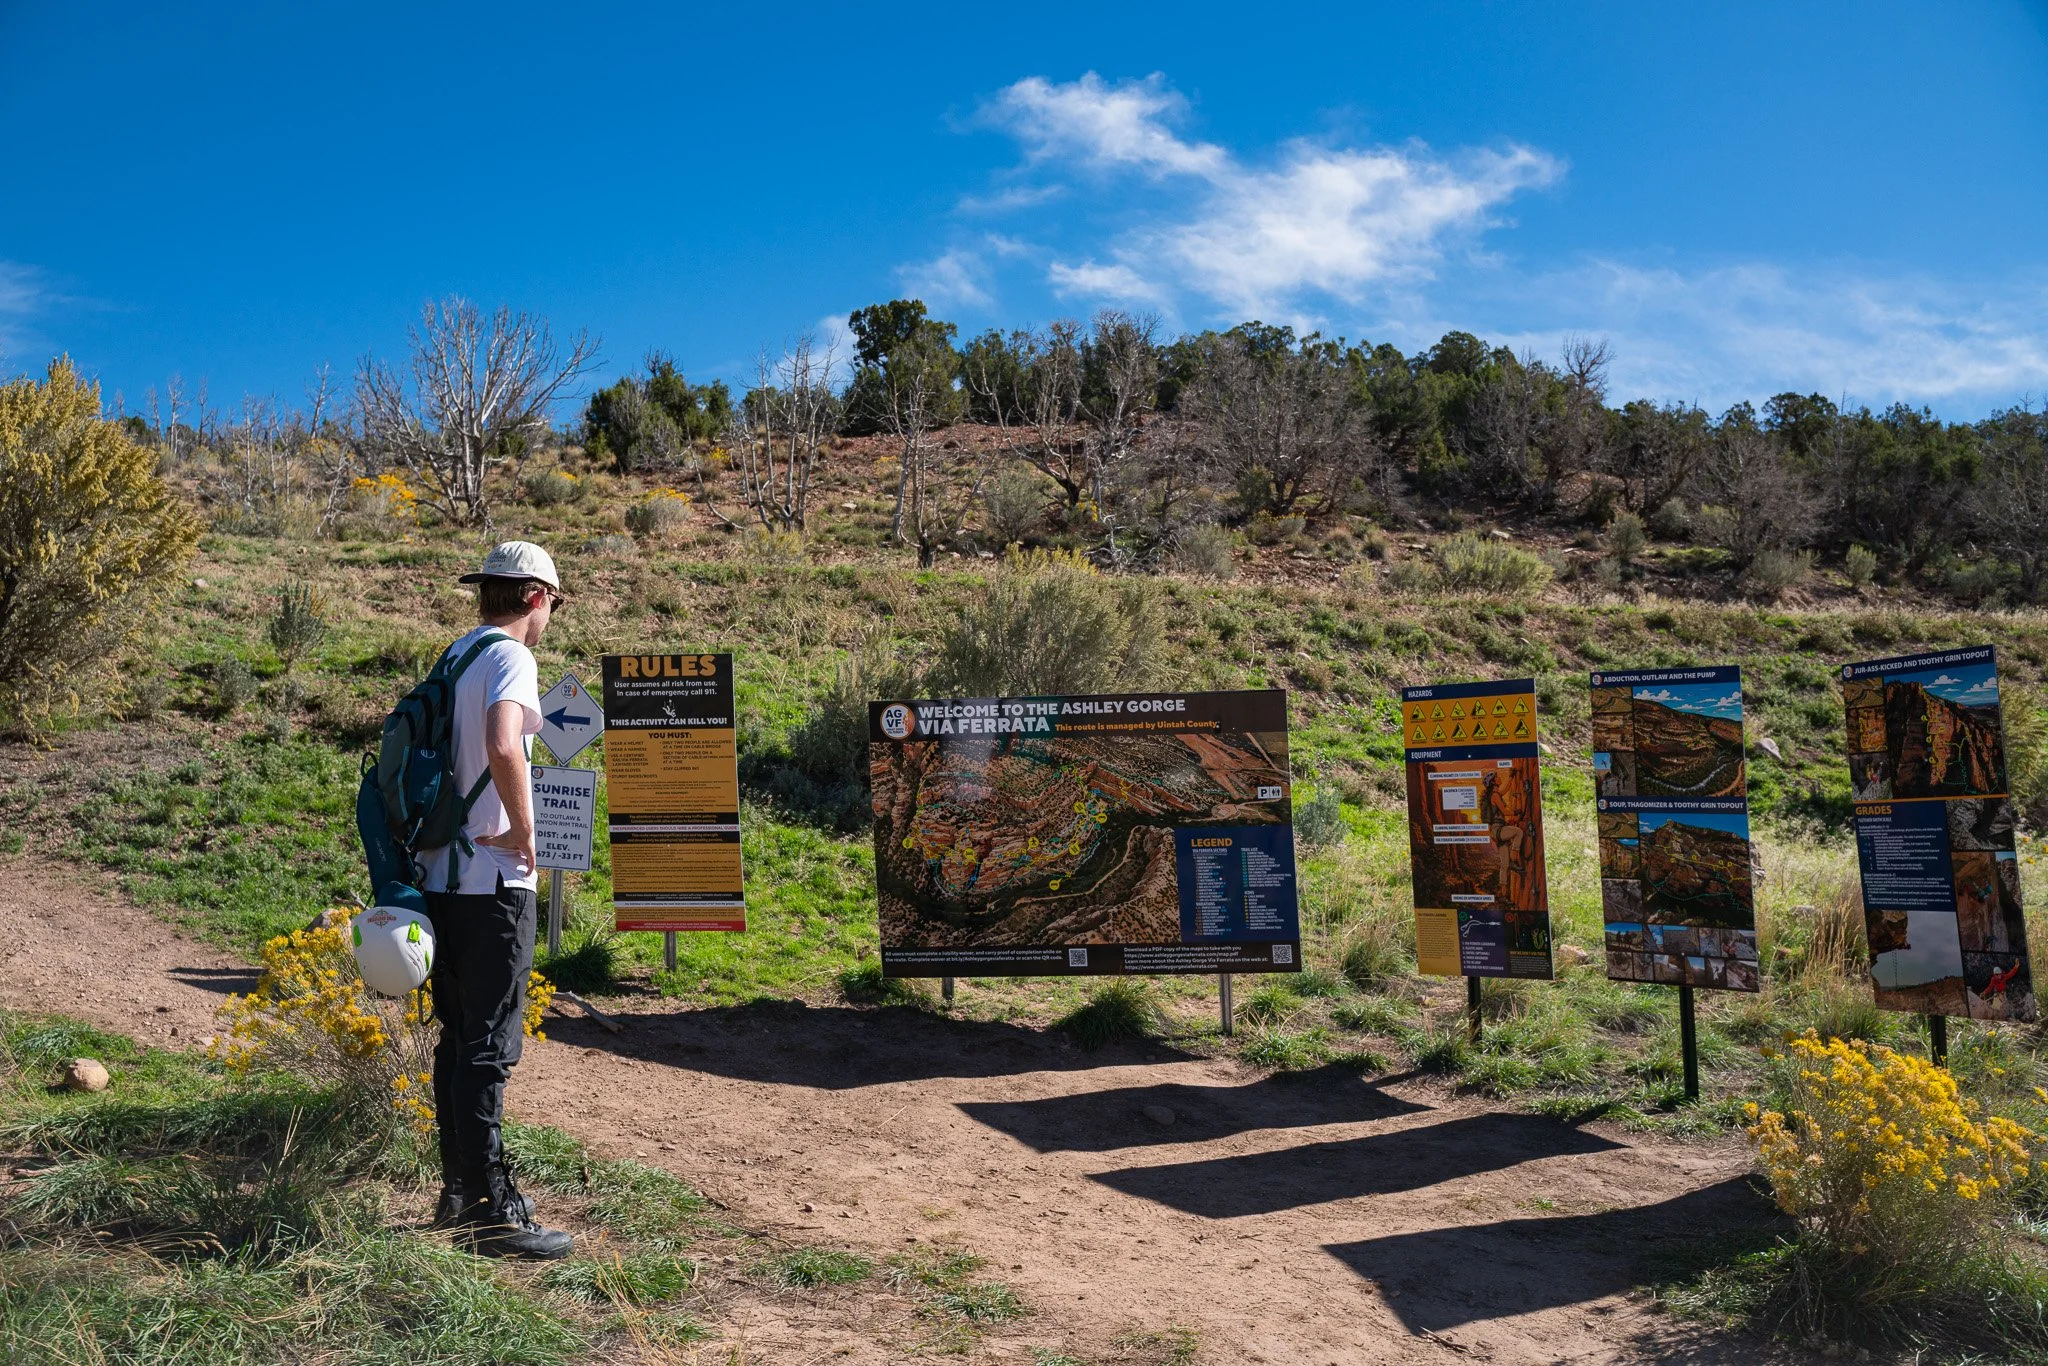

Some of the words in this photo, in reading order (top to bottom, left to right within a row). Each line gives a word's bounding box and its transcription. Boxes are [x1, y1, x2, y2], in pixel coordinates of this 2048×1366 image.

[621, 655, 716, 678] RULES
[1854, 662, 1902, 674] JUR-ASS-KICKED
[1904, 660, 1917, 668] AND
[1918, 656, 1944, 665] TOOTHY
[1945, 654, 1961, 662] GRIN
[1962, 650, 1990, 660] TOPOUT
[1408, 690, 1432, 698] HAZARDS
[918, 705, 999, 718] WELCOME
[1002, 704, 1024, 716] TO
[1027, 703, 1058, 715] THE
[1061, 701, 1123, 714] ASHLEY
[1127, 699, 1185, 712] GORGE
[886, 710, 902, 718] AG
[886, 719, 901, 727] VF
[918, 720, 953, 735] VIA
[958, 717, 1050, 734] FERRATA
[1106, 722, 1144, 731] managed
[1145, 721, 1156, 730] by
[1411, 750, 1441, 759] EQUIPMENT
[534, 783, 590, 797] SUNRISE
[1261, 789, 1267, 797] P
[542, 798, 580, 810] TRAIL
[1856, 806, 1892, 815] GRADES
[538, 831, 558, 839] DIST:
[546, 843, 570, 851] ELEV.
[1191, 838, 1233, 847] LEGEND
[552, 852, 556, 860] /
